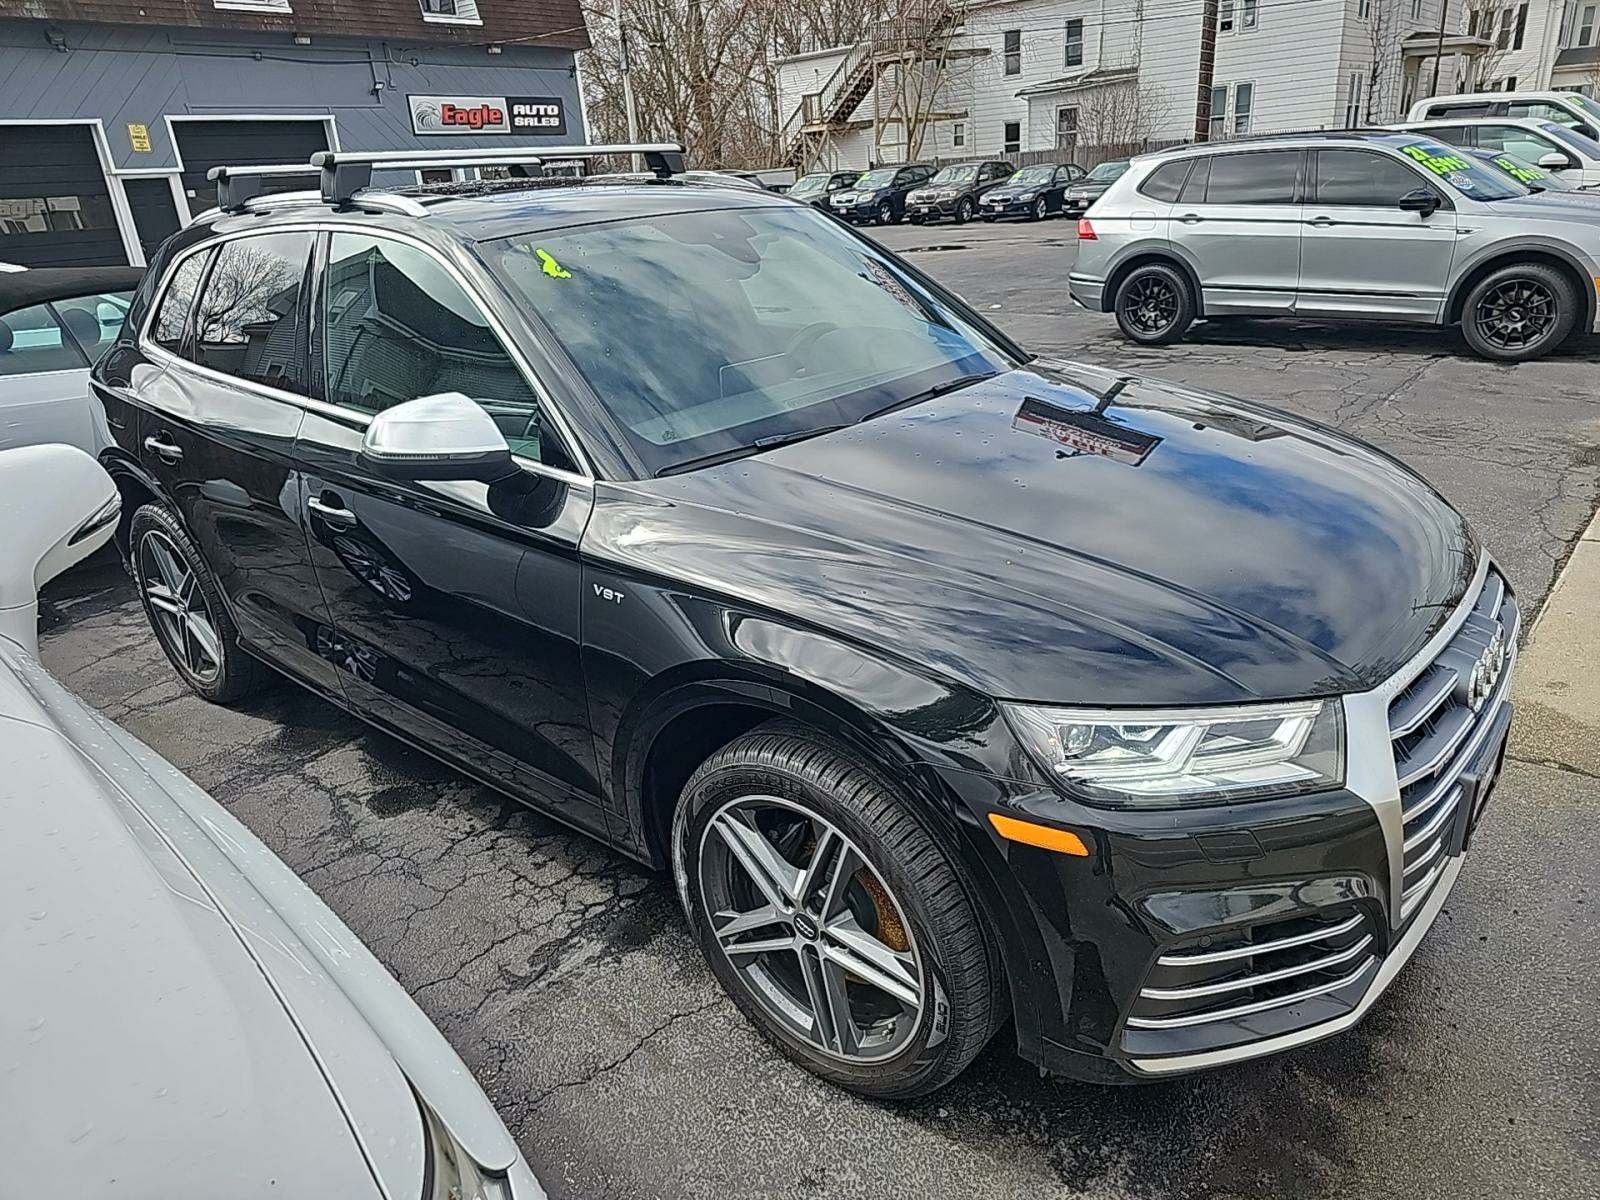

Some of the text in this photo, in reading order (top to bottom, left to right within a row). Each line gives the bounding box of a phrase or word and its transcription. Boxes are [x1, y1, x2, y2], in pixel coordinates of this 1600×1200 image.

[513, 104, 559, 115] AUTO
[442, 104, 503, 129] Eagle
[514, 116, 560, 126] SALES
